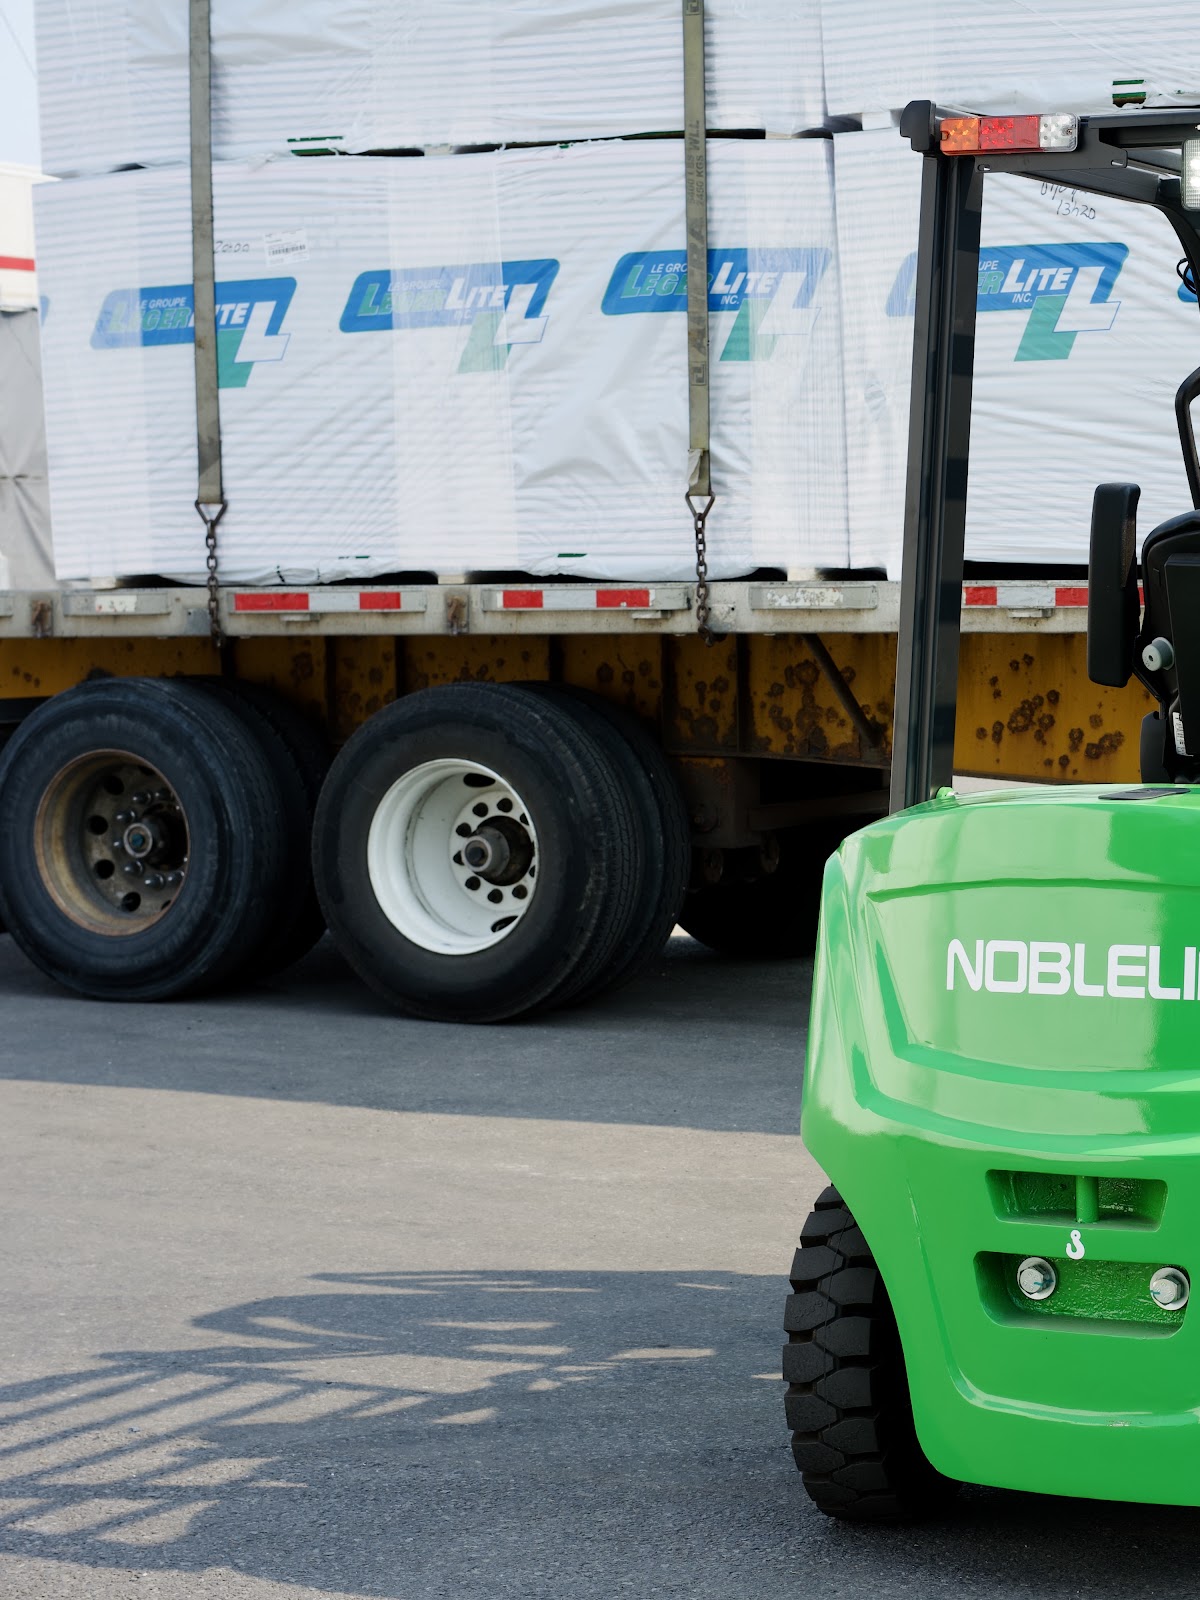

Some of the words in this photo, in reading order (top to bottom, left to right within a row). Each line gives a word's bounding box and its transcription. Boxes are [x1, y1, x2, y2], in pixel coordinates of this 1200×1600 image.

[651, 263, 664, 273] LE
[148, 297, 187, 309] GROUPE
[720, 295, 740, 305] INC.
[1012, 292, 1033, 304] INC.
